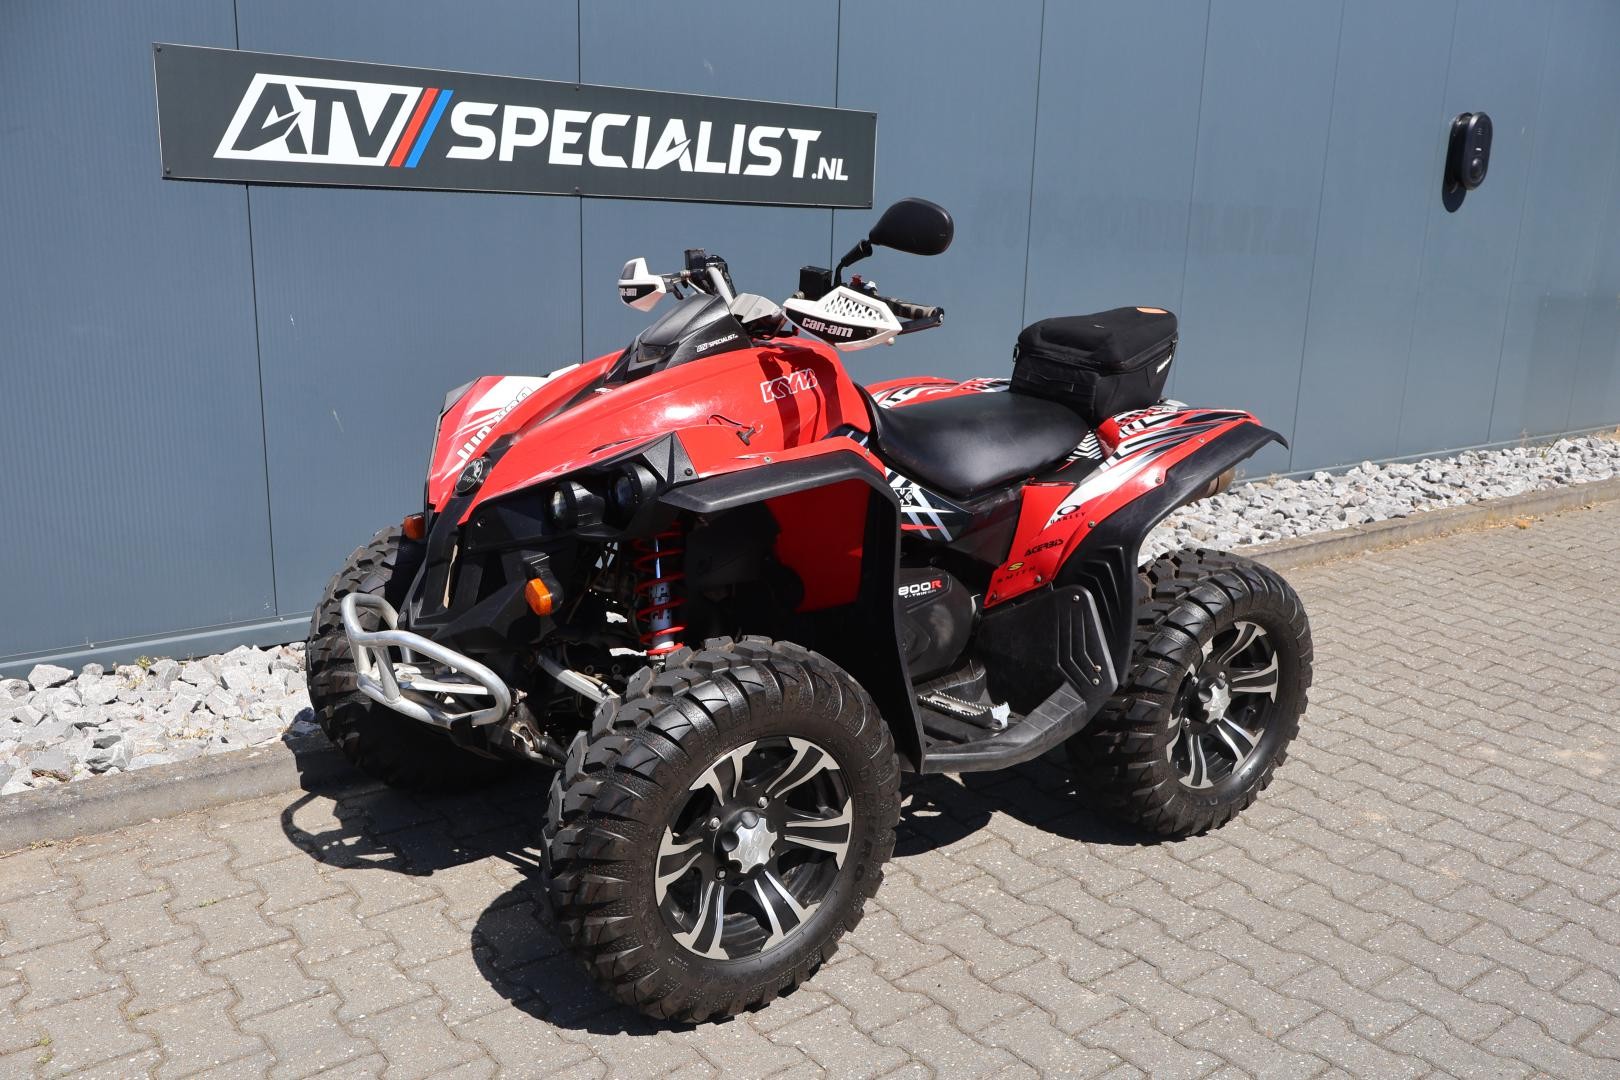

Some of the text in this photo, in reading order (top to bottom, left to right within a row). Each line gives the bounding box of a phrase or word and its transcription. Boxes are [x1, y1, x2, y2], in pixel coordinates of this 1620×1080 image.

[213, 73, 424, 168] ATV
[801, 317, 853, 338] can-am
[898, 579, 943, 596] 800R
